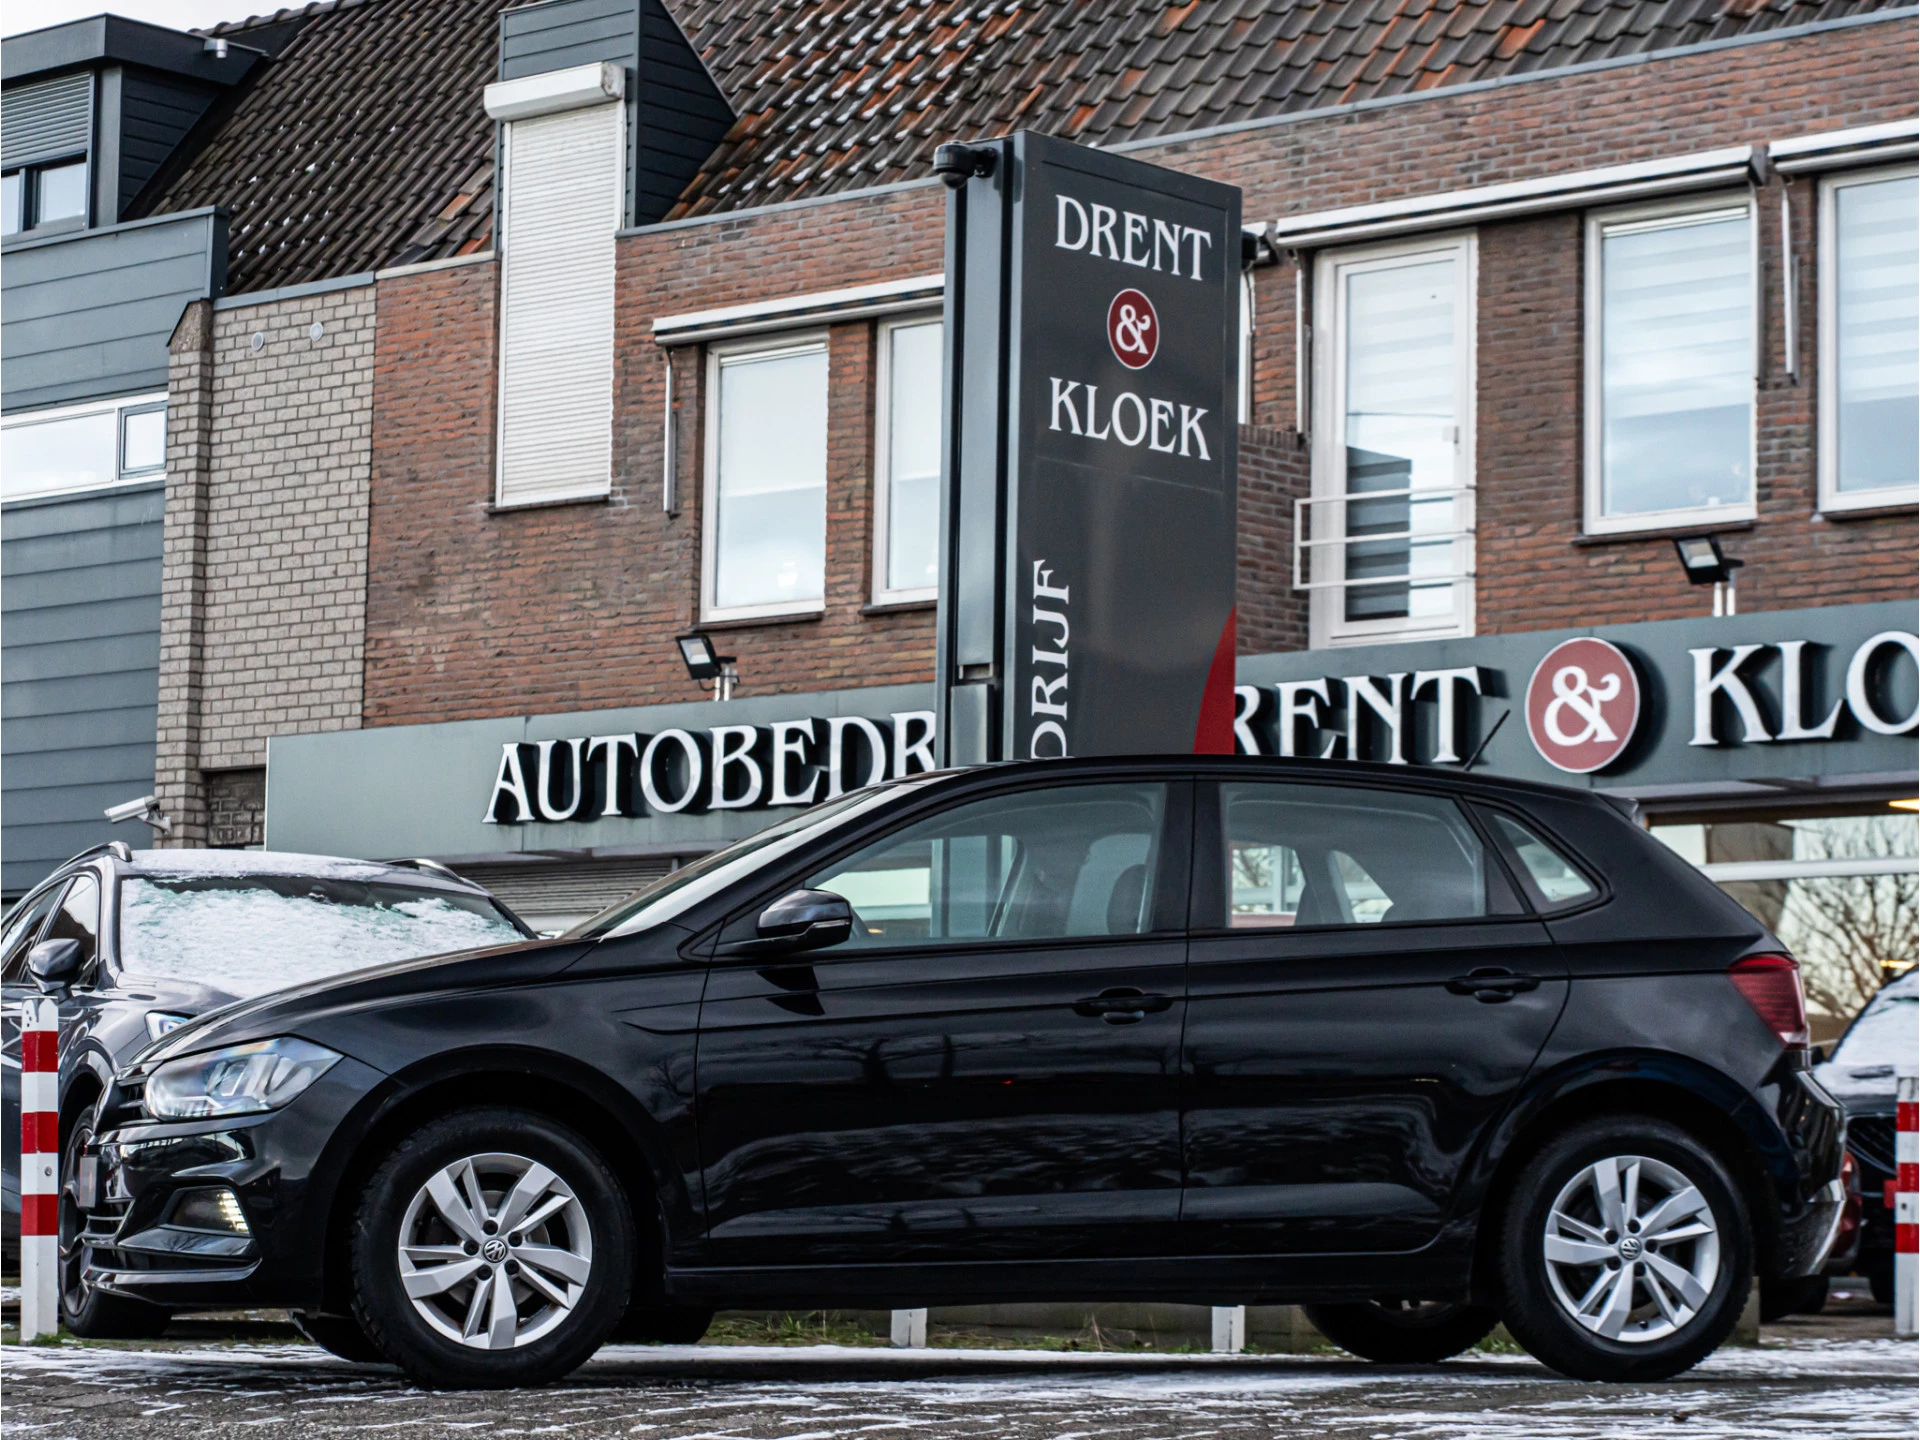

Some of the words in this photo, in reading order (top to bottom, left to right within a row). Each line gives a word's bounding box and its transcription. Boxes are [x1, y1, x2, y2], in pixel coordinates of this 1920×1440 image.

[1054, 194, 1212, 281] DRENT
[1115, 304, 1151, 355] &
[1049, 376, 1211, 461] KLOEK
[1030, 559, 1070, 759] DRIJF
[482, 710, 936, 823] AUTOBEDR
[1543, 665, 1621, 747] &
[1687, 630, 1919, 746] KLO
